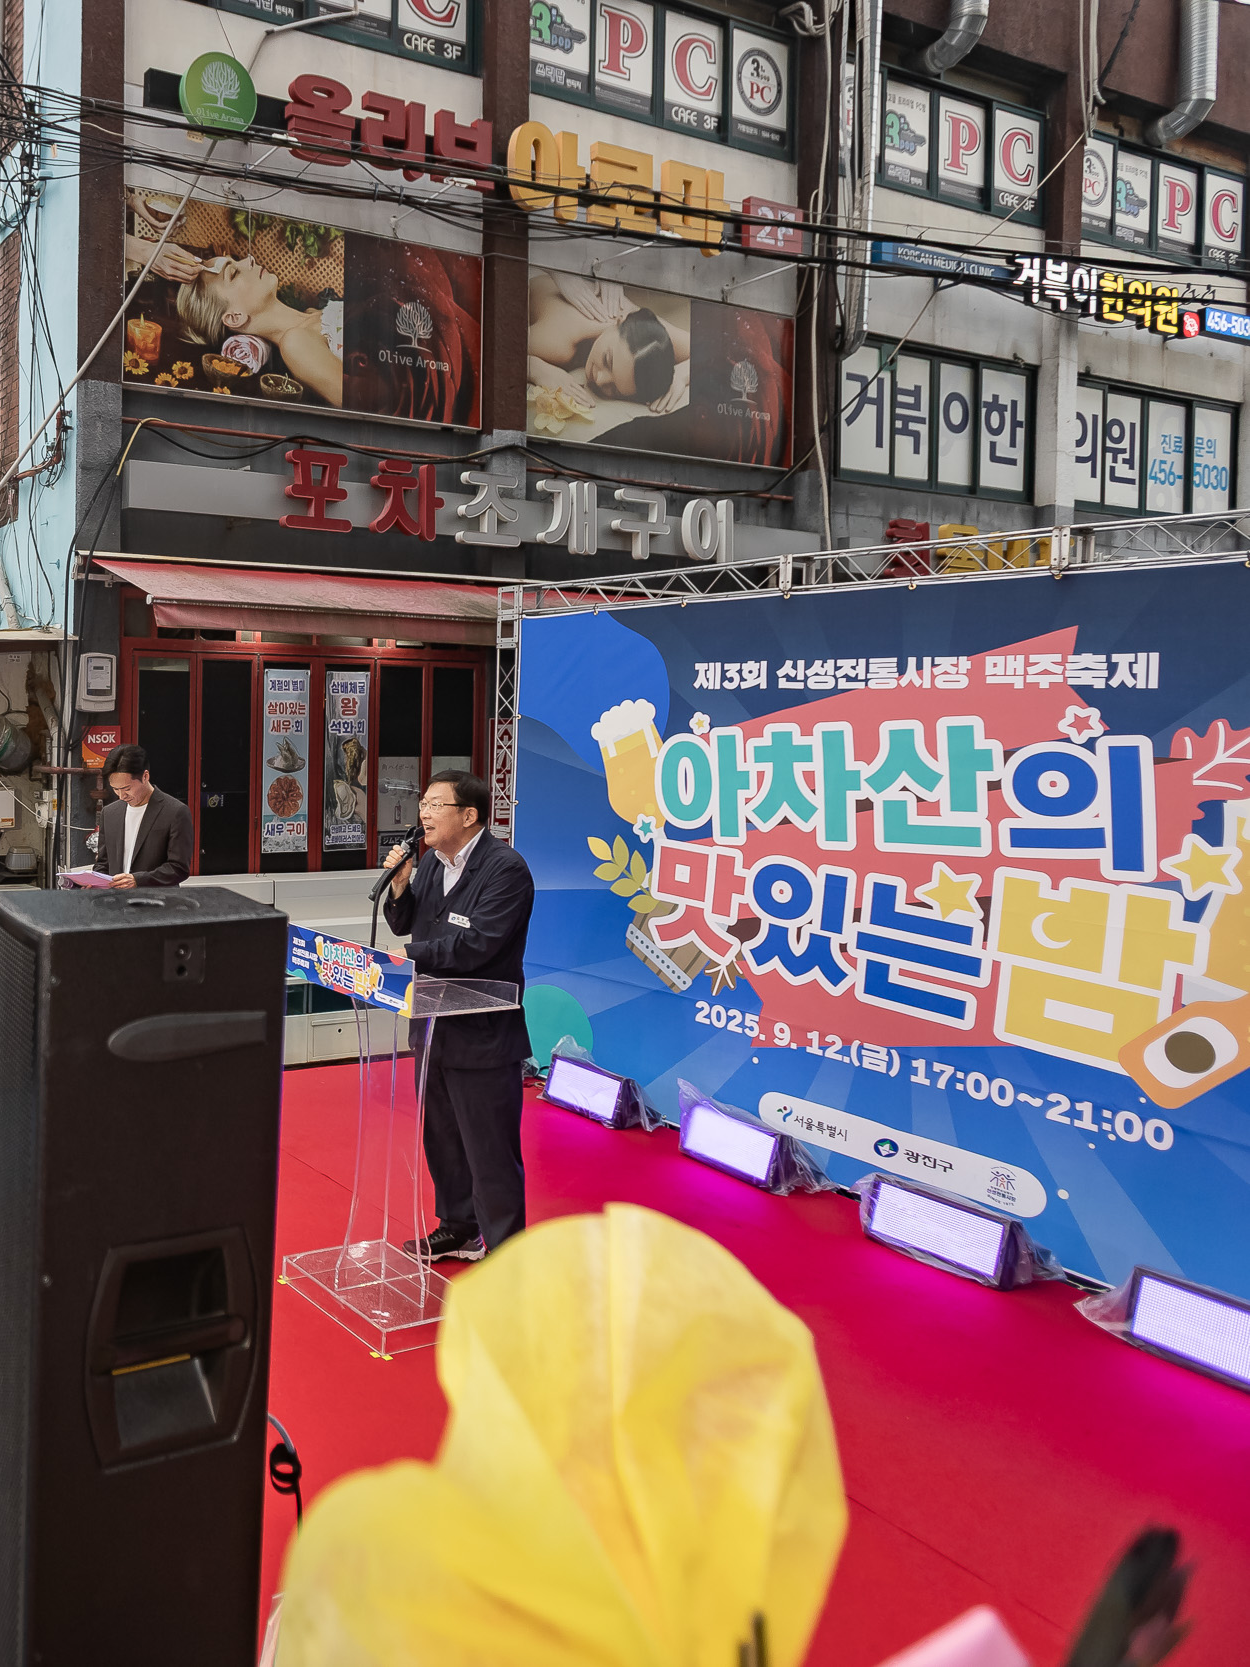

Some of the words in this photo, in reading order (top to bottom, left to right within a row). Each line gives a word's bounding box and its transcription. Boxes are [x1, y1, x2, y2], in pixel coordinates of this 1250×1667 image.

[403, 32, 436, 55] CAFE
[443, 43, 462, 60] 3F
[749, 81, 772, 104] PC
[196, 107, 220, 119] Olive
[221, 112, 245, 124] Aroma
[671, 106, 698, 127] CAFE
[703, 115, 719, 131] 3F
[284, 73, 494, 190] 올리브
[507, 121, 731, 258] 아로마
[999, 192, 1019, 207] CAFE
[1083, 179, 1101, 197] PC
[897, 245, 934, 264] KOREAN
[934, 253, 968, 272] MEDICAL
[968, 261, 996, 278] CLINIC
[378, 349, 413, 366] Olive
[415, 356, 450, 371] Aroma
[717, 403, 743, 416] Olive
[745, 408, 771, 421] Aroma
[693, 660, 768, 692] 제3회
[776, 657, 971, 691] 신성전통시장
[984, 651, 1161, 691] 맥주축제
[269, 679, 291, 692] 계절의
[331, 681, 366, 694] 삼배체굴
[267, 701, 307, 716] 살아있는
[340, 697, 359, 716] 왕
[87, 734, 116, 744] NSOK
[654, 714, 1158, 883] 아차산의
[265, 822, 285, 836] 새우
[286, 822, 305, 836] 구이
[323, 942, 368, 972] 아차산의
[650, 843, 991, 1030] 맛있는
[989, 866, 1210, 1074] 밤
[321, 961, 354, 993] 맛있는
[694, 1000, 766, 1042] 2025.
[772, 1025, 798, 1050] 9.
[910, 1058, 1174, 1152] 17:00~21:00
[793, 1115, 848, 1142] 서울특별시
[903, 1148, 955, 1174] 광진구
